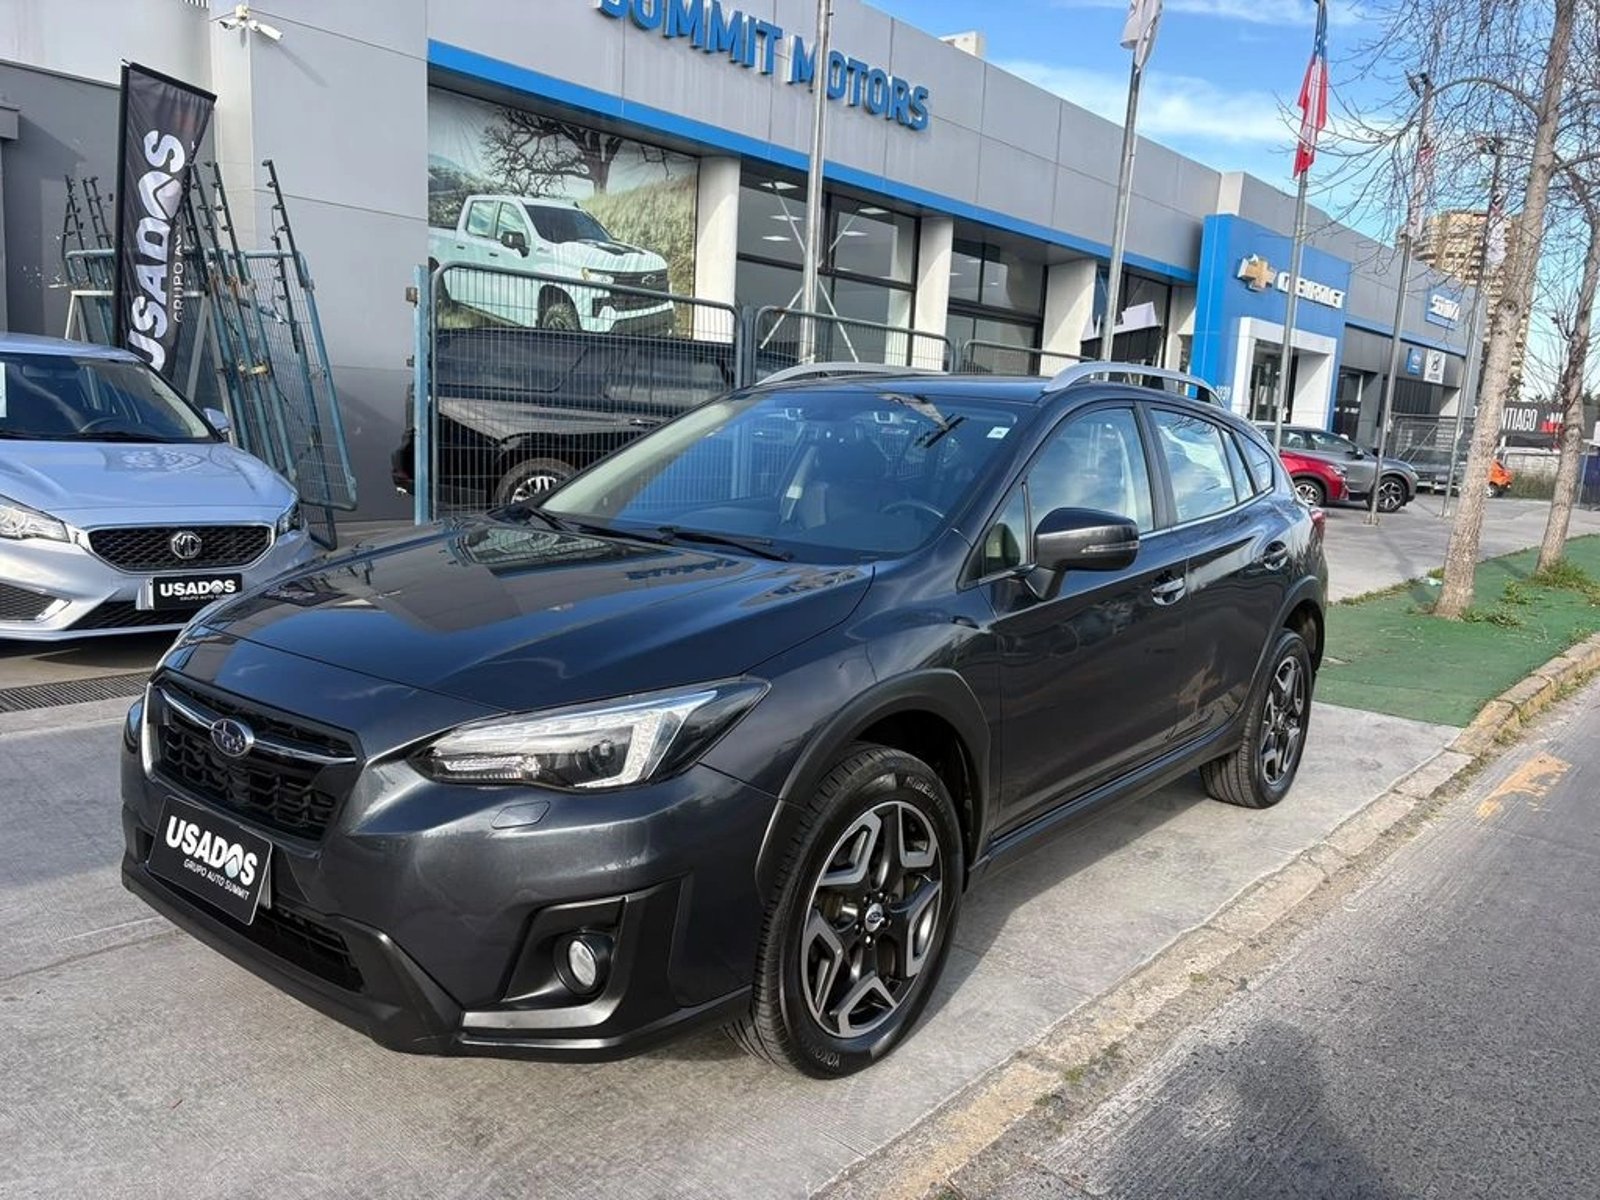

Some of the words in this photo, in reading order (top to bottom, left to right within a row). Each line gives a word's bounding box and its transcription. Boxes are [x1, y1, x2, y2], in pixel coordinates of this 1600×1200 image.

[788, 34, 929, 131] MOTORS
[128, 130, 185, 373] USADOS
[1277, 271, 1346, 309] CEVROLET
[1501, 407, 1538, 431] NTIAGO
[160, 580, 236, 597] USADOS
[165, 815, 258, 886] USADOS
[183, 858, 207, 877] GRUPO
[207, 871, 226, 888] AUTO
[225, 880, 250, 901] SUMMIT
